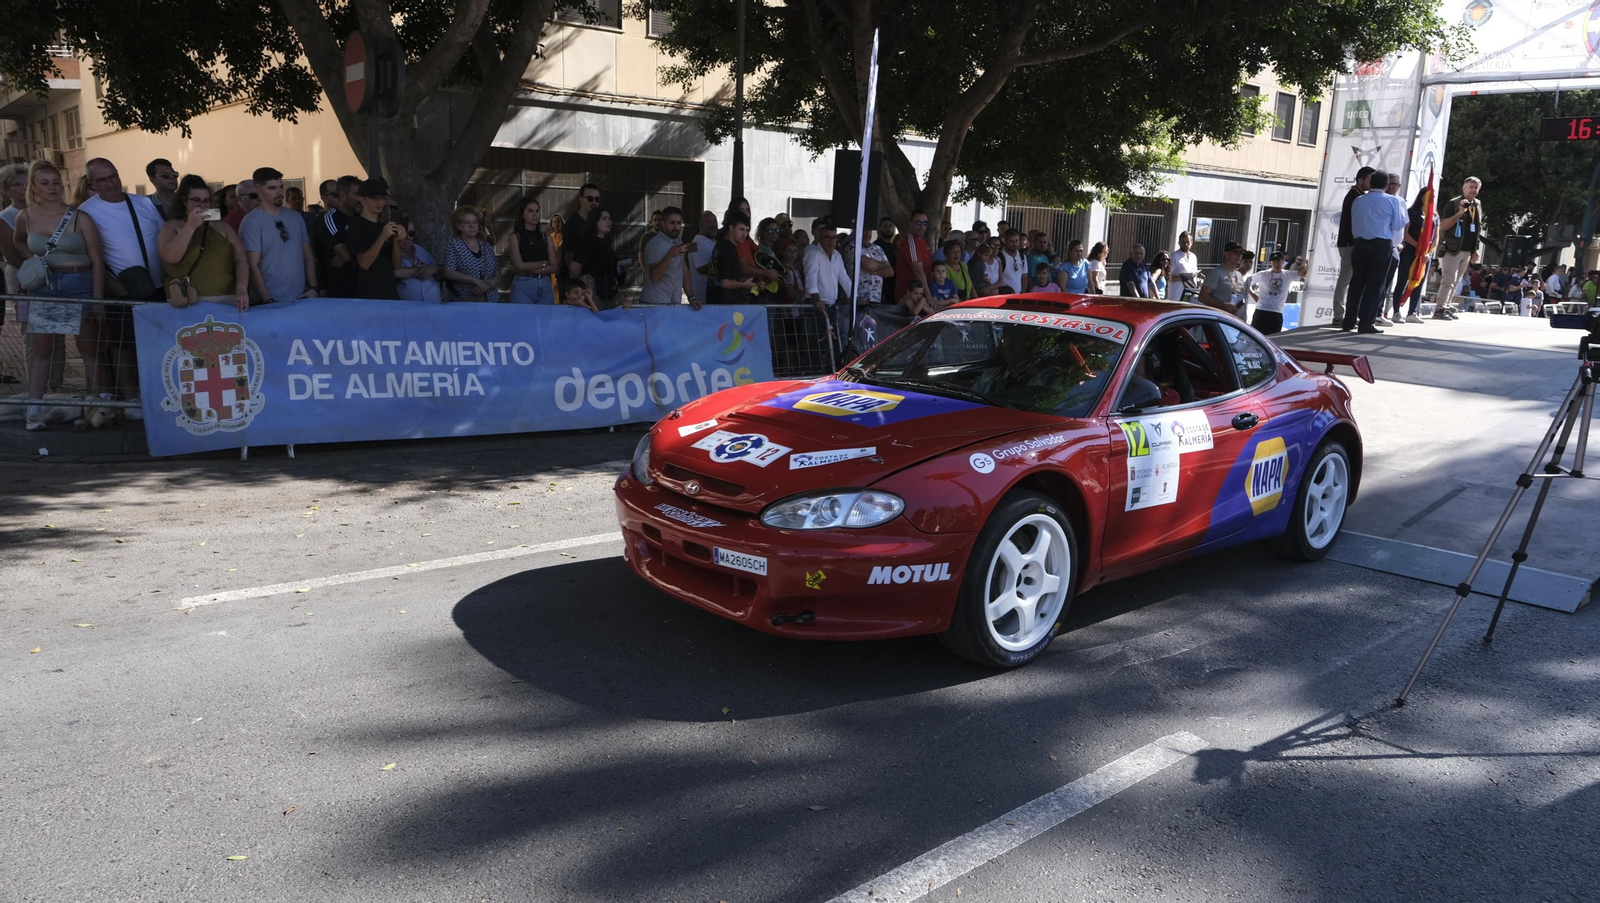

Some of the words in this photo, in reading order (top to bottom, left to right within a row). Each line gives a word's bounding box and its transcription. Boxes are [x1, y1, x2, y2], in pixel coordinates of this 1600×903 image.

[1007, 313, 1126, 341] COSTASOL
[287, 338, 535, 366] AYUNTAMIENTO
[288, 373, 333, 400] DE
[345, 368, 485, 399] ALMERÍA
[554, 362, 755, 419] deportes
[809, 392, 890, 412] NAPA
[992, 443, 1027, 460] Grupo
[1024, 433, 1065, 450] Salvador
[1120, 421, 1150, 457] 12
[1152, 440, 1172, 448] CUPRA
[1185, 432, 1212, 446] ALMERÍA
[754, 447, 781, 462] 12
[1252, 456, 1284, 498] NAPA
[719, 551, 766, 572] MA2605CH
[867, 562, 951, 585] MOTUL
[808, 573, 822, 586] OMP
